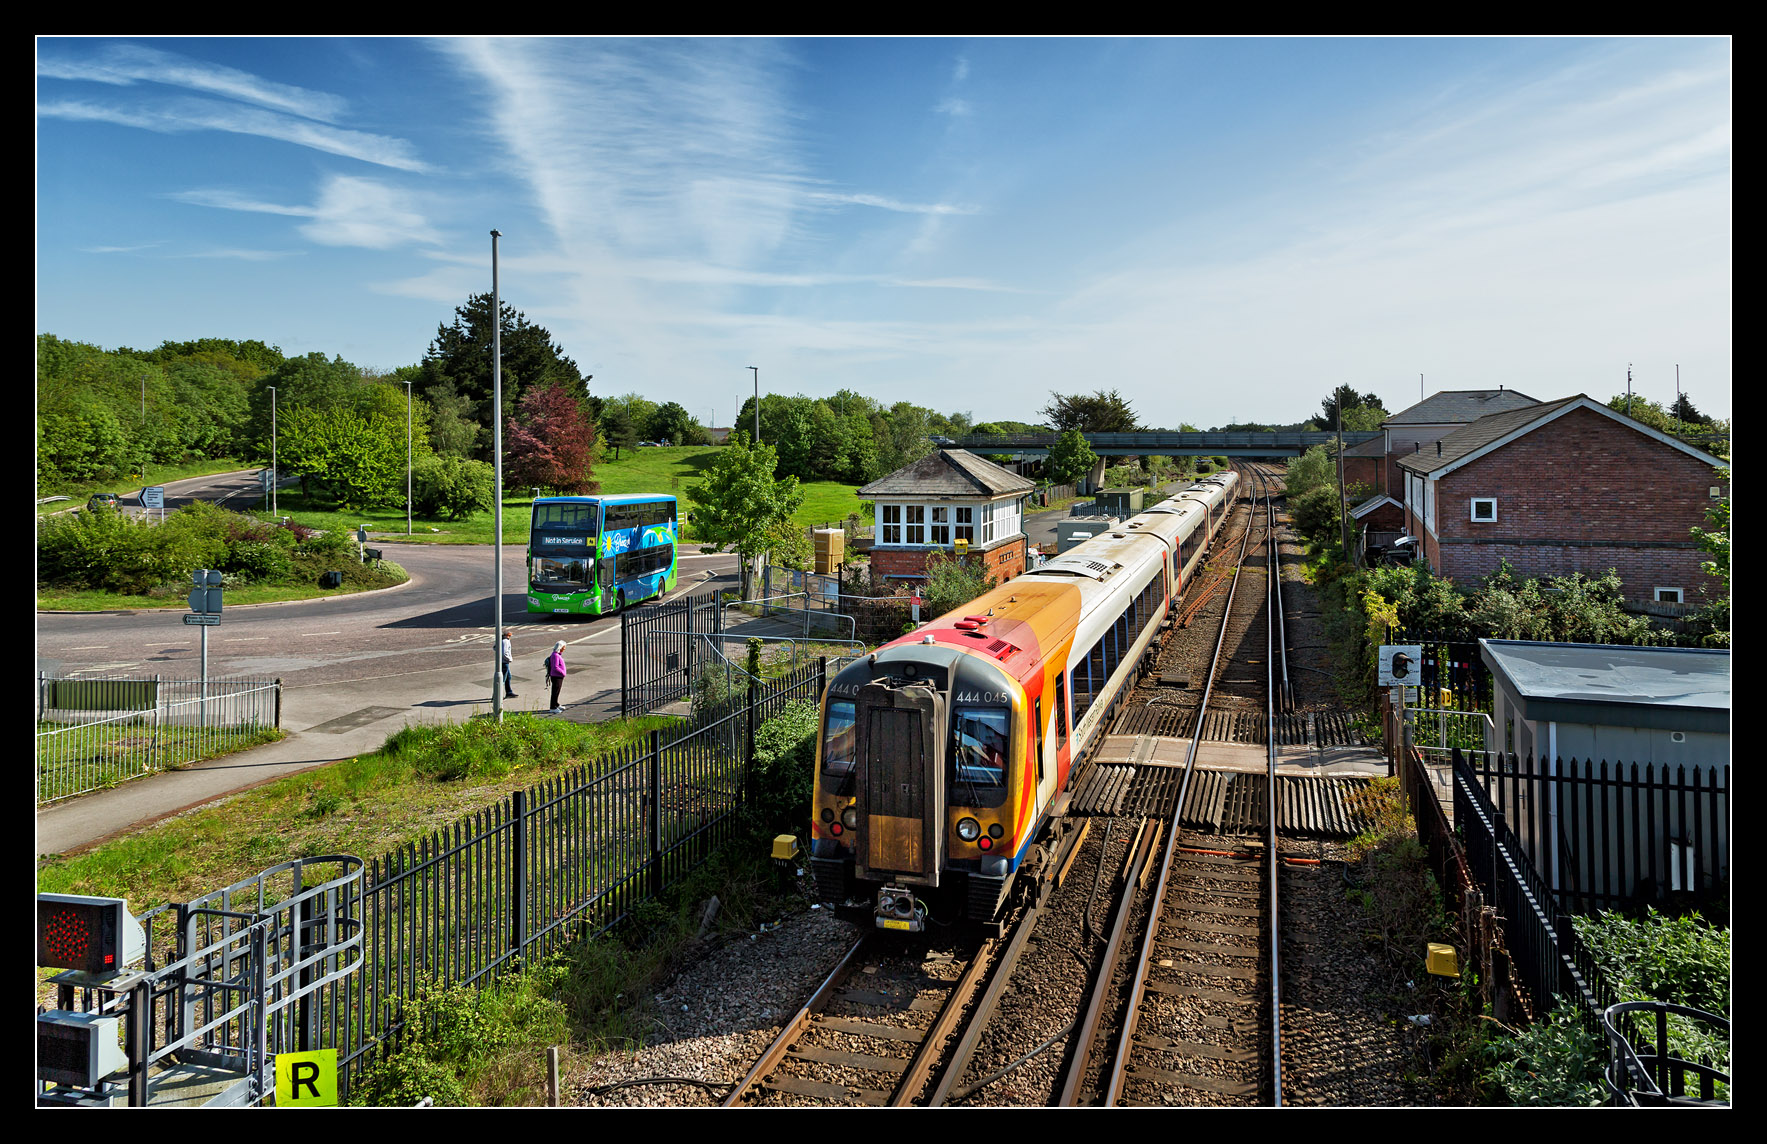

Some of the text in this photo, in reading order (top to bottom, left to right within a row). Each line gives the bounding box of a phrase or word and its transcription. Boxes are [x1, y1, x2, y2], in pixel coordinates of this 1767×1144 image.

[830, 683, 850, 695] 444
[956, 691, 1008, 703] 444 045
[291, 1061, 321, 1100] R
